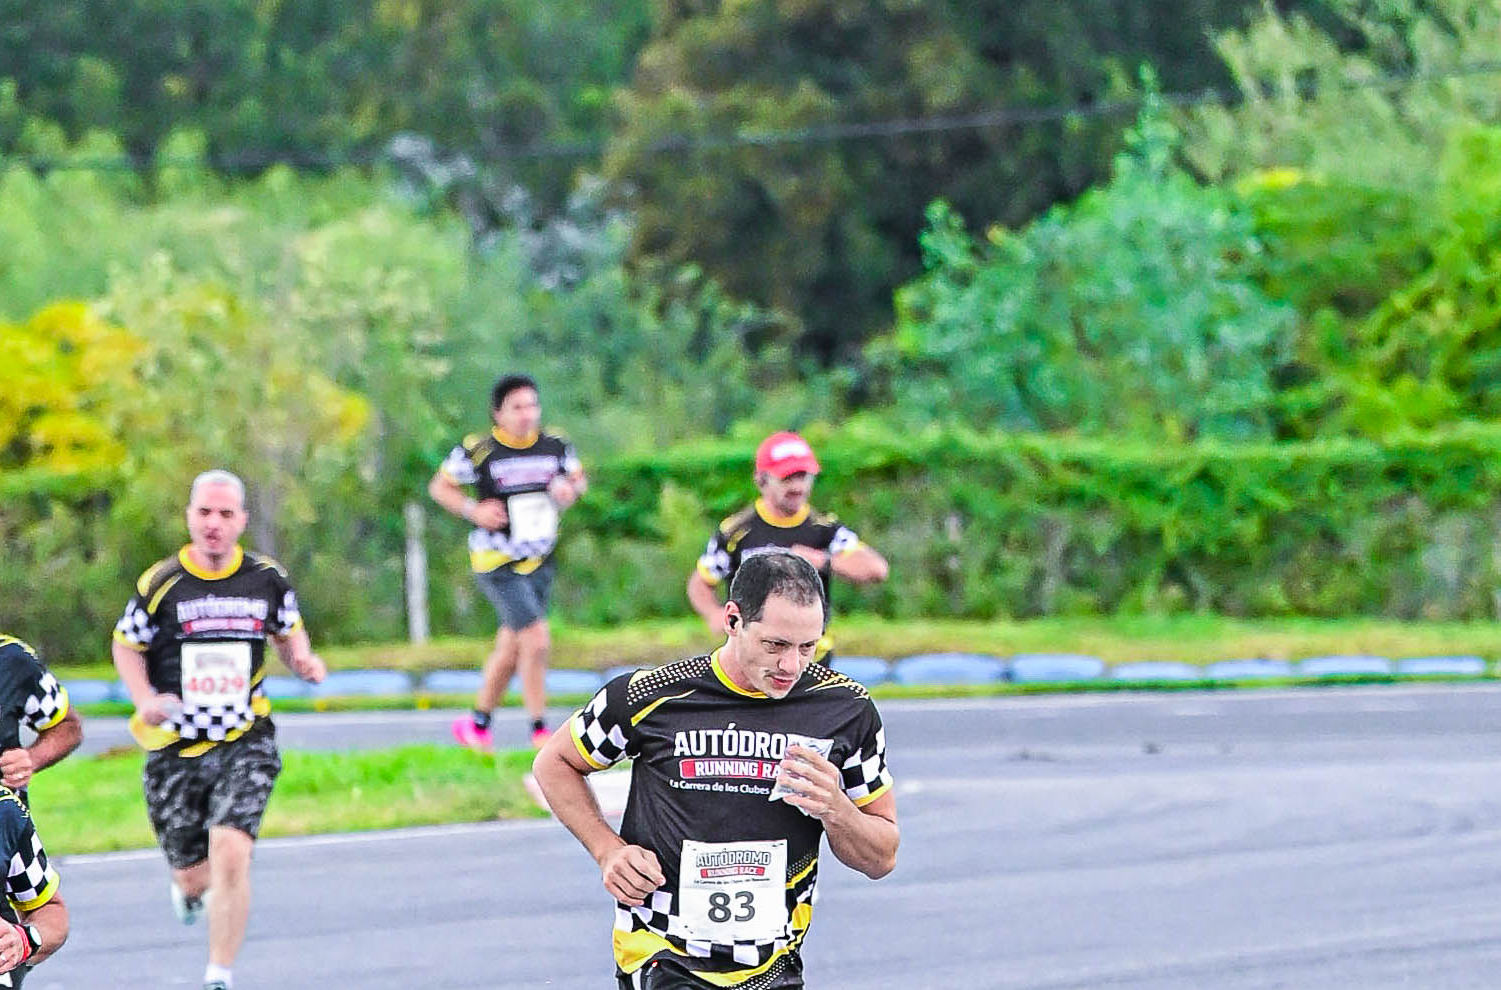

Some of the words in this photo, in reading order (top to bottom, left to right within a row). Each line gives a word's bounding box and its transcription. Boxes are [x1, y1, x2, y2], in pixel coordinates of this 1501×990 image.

[673, 722, 787, 760] AUTÓDRO
[694, 760, 758, 777] RUNNING
[761, 762, 781, 779] RA
[669, 779, 679, 788] La
[679, 781, 711, 791] Carrera
[712, 782, 724, 792] de
[725, 783, 739, 792] los
[740, 784, 771, 795] Clubes
[696, 847, 771, 867] AUTÓDROMO
[708, 891, 755, 922] 83
